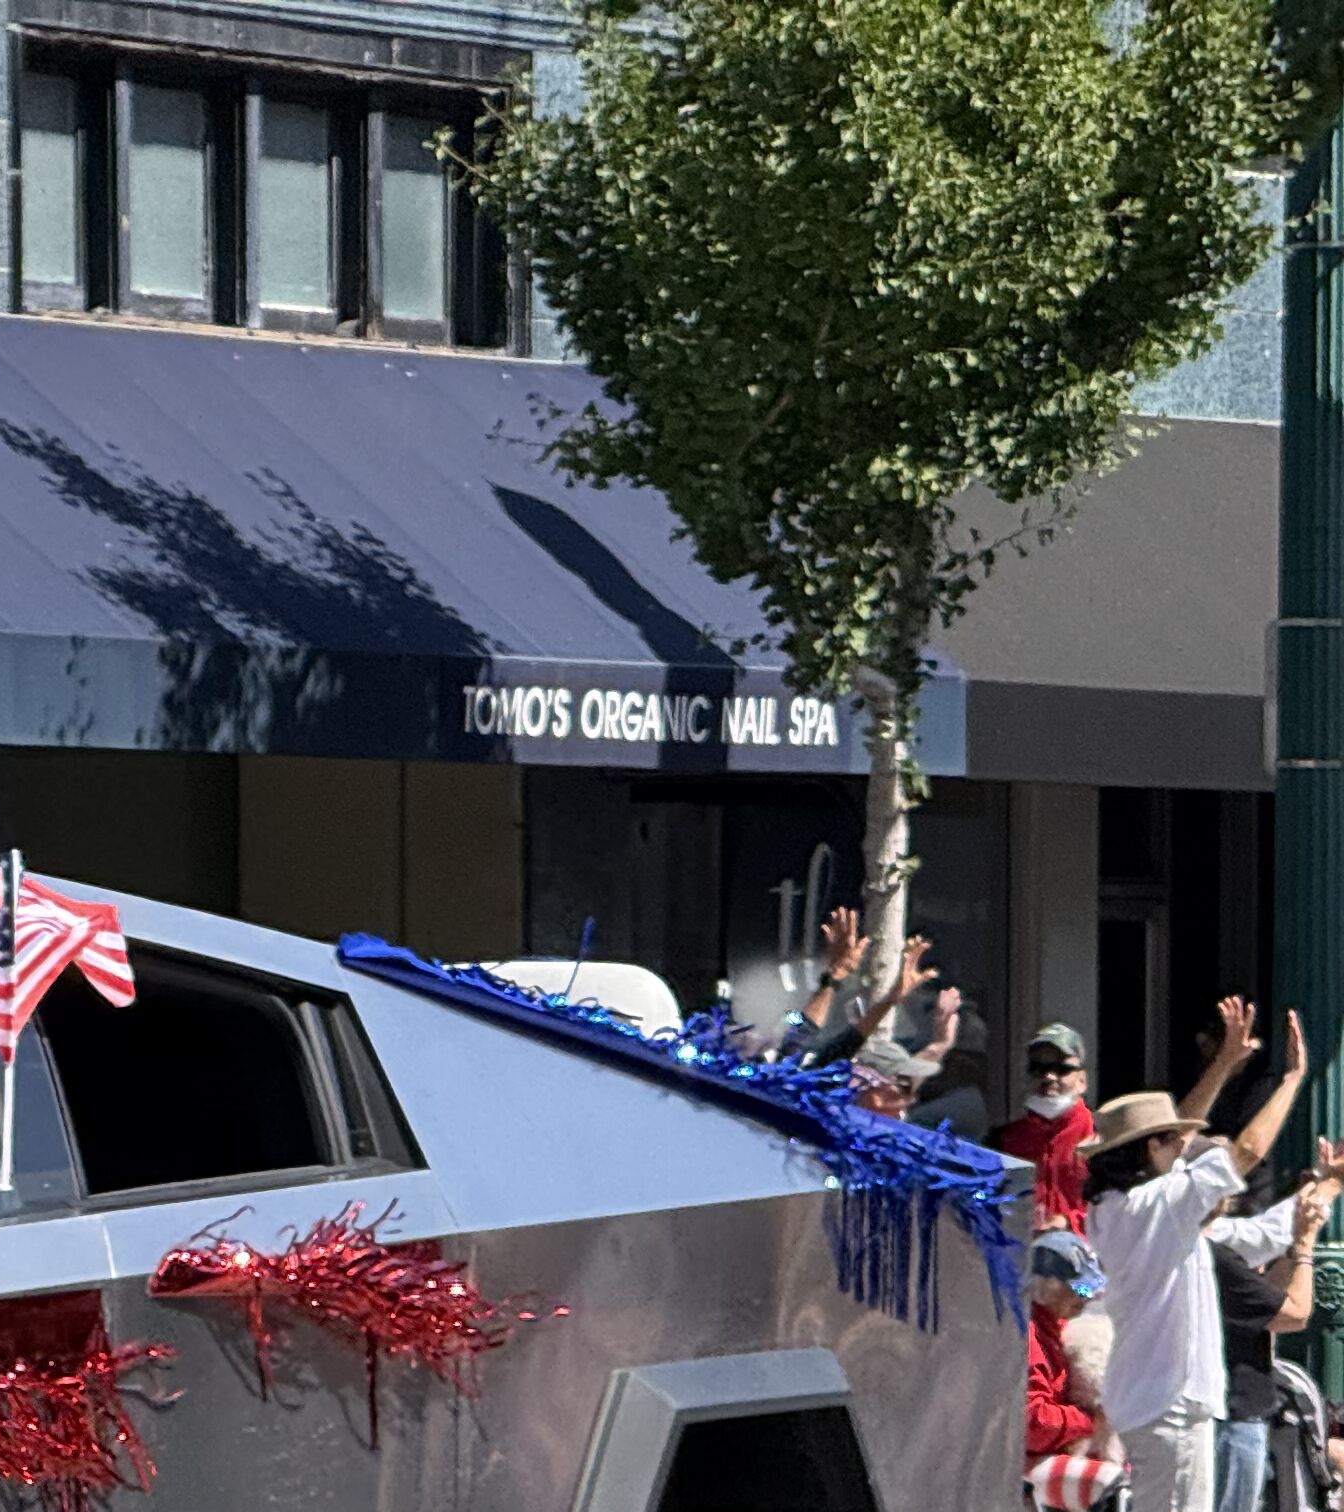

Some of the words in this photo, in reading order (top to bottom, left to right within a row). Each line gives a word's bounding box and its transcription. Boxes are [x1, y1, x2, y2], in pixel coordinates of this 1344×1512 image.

[463, 685, 572, 738] TOMO'S
[580, 688, 710, 743] ORGANIC
[721, 697, 780, 745] NAIL
[788, 696, 838, 746] SPA
